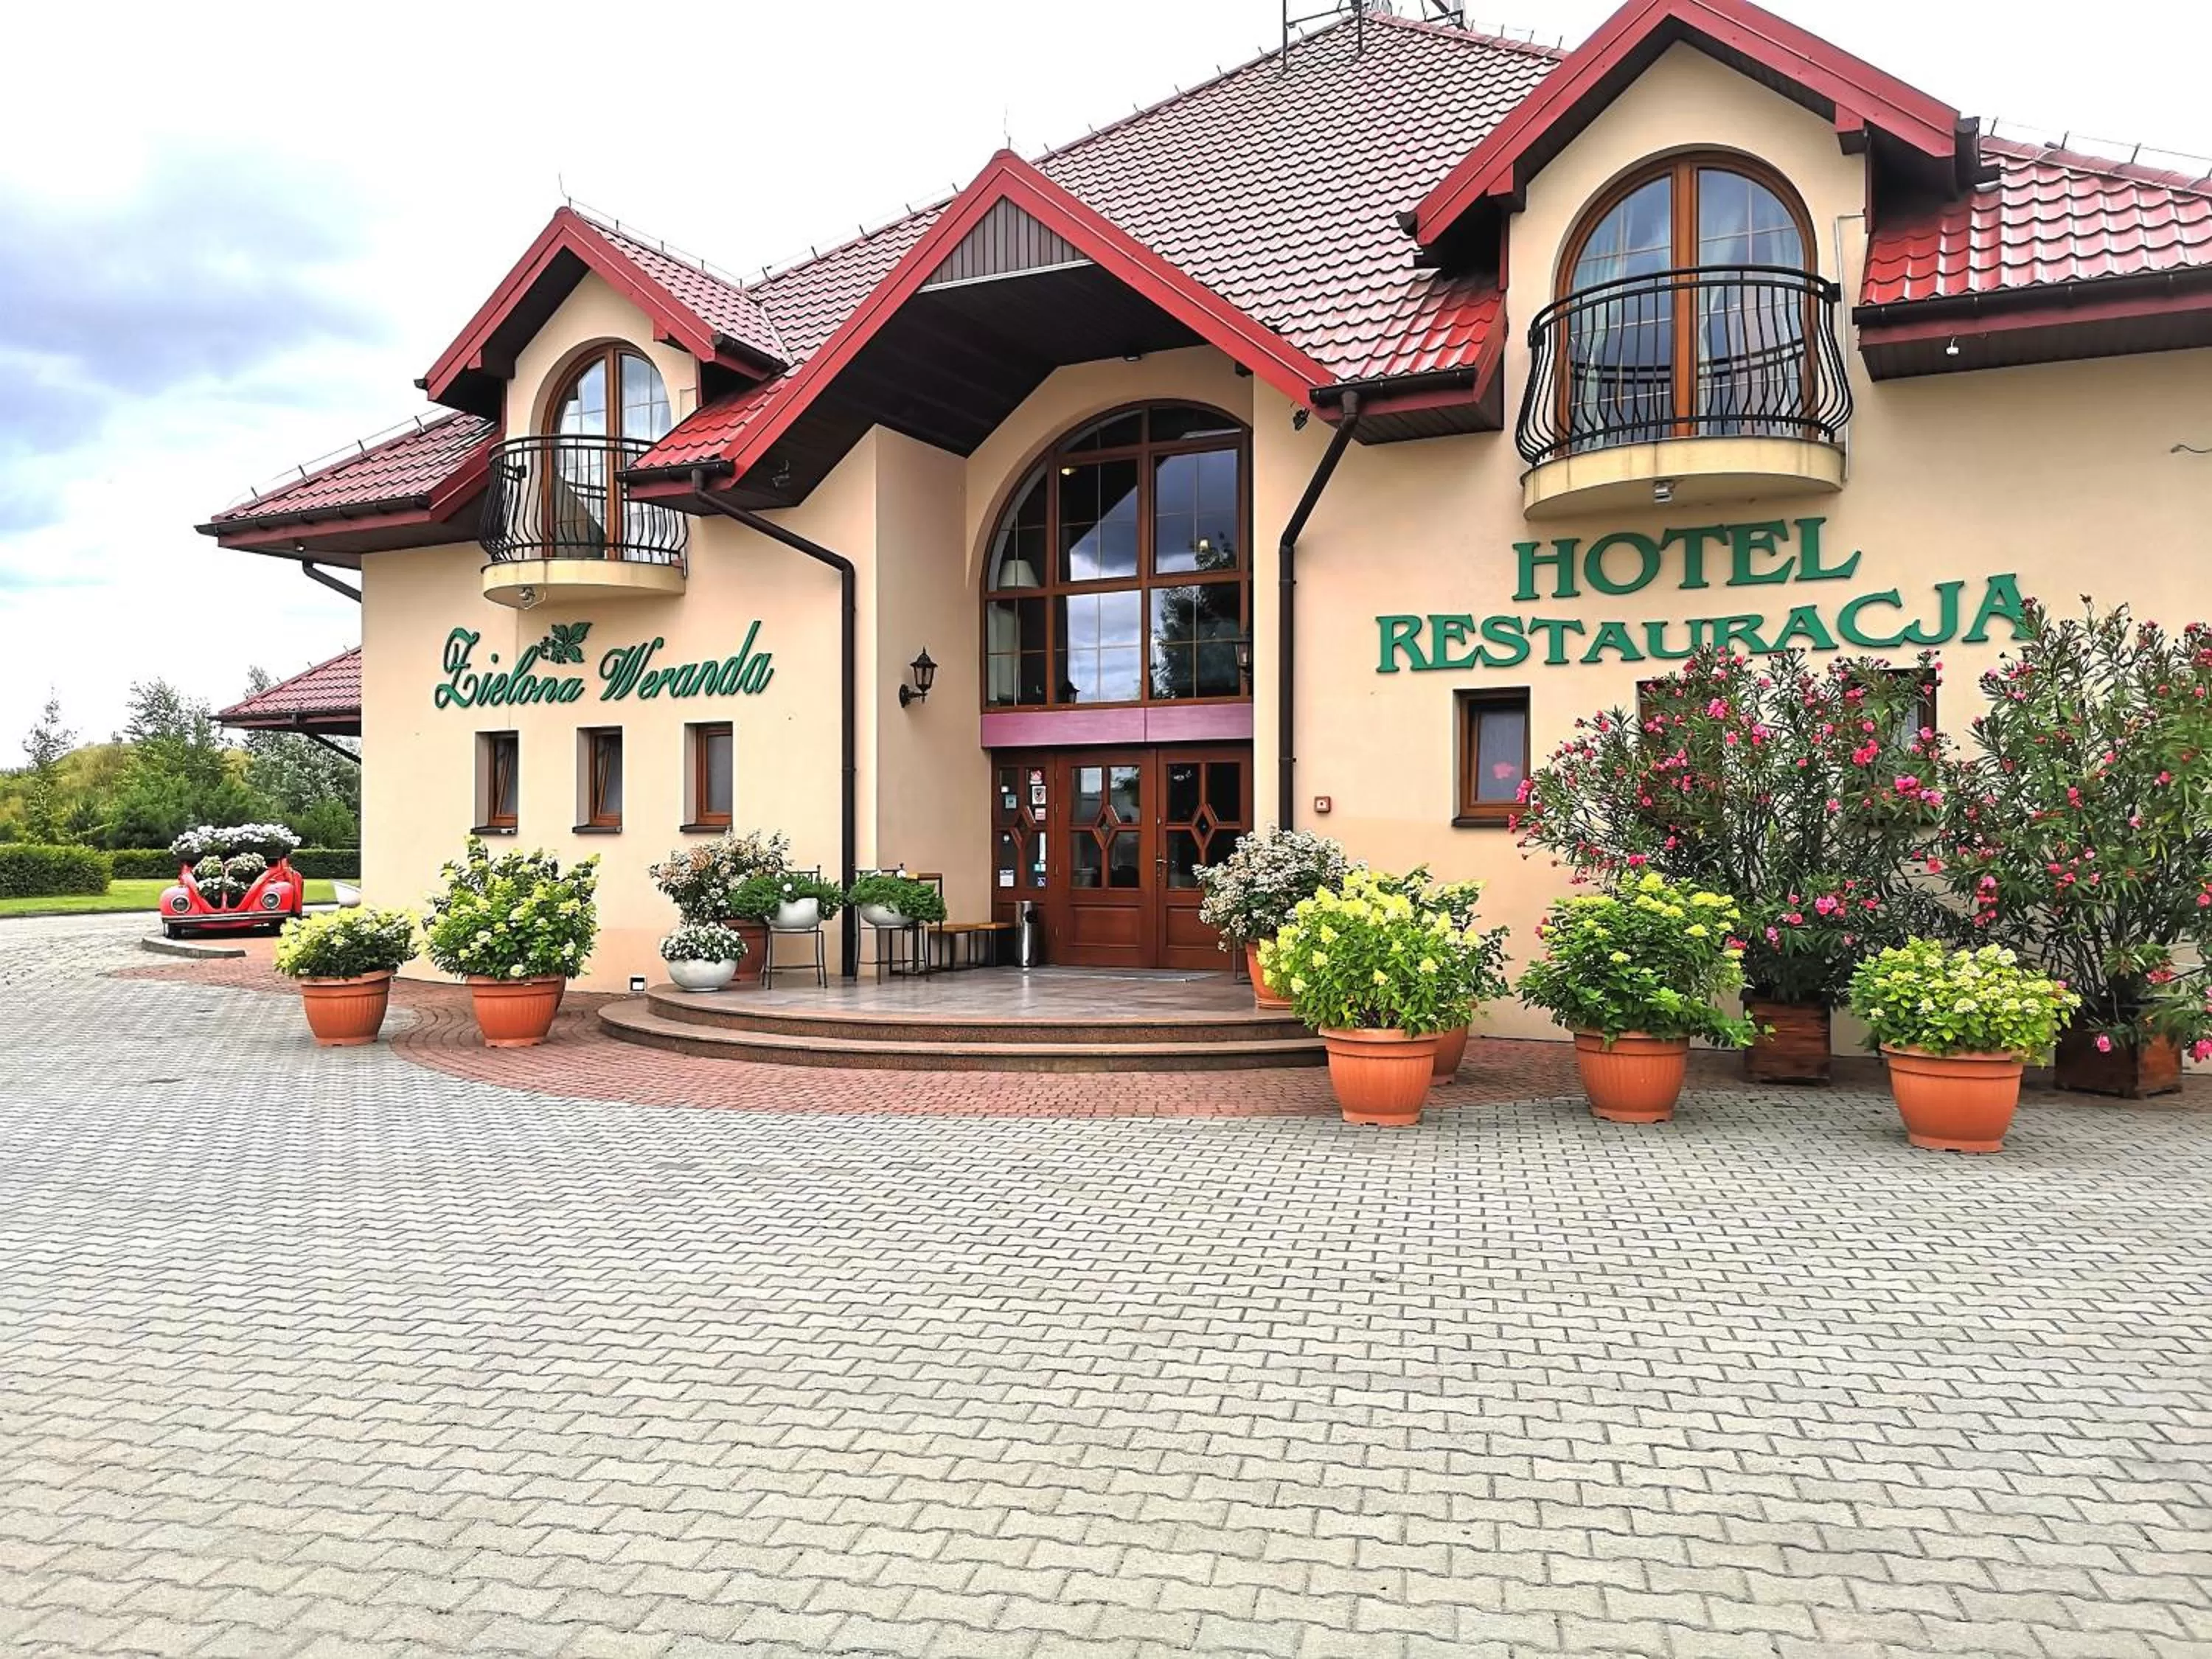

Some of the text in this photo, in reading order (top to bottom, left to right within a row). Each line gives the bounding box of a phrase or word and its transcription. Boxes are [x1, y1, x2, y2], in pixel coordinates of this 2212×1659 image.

[1512, 516, 1862, 601] HOTEL
[434, 620, 775, 709] Zielona Weranda
[1376, 573, 2033, 673] RESTAURACJA
